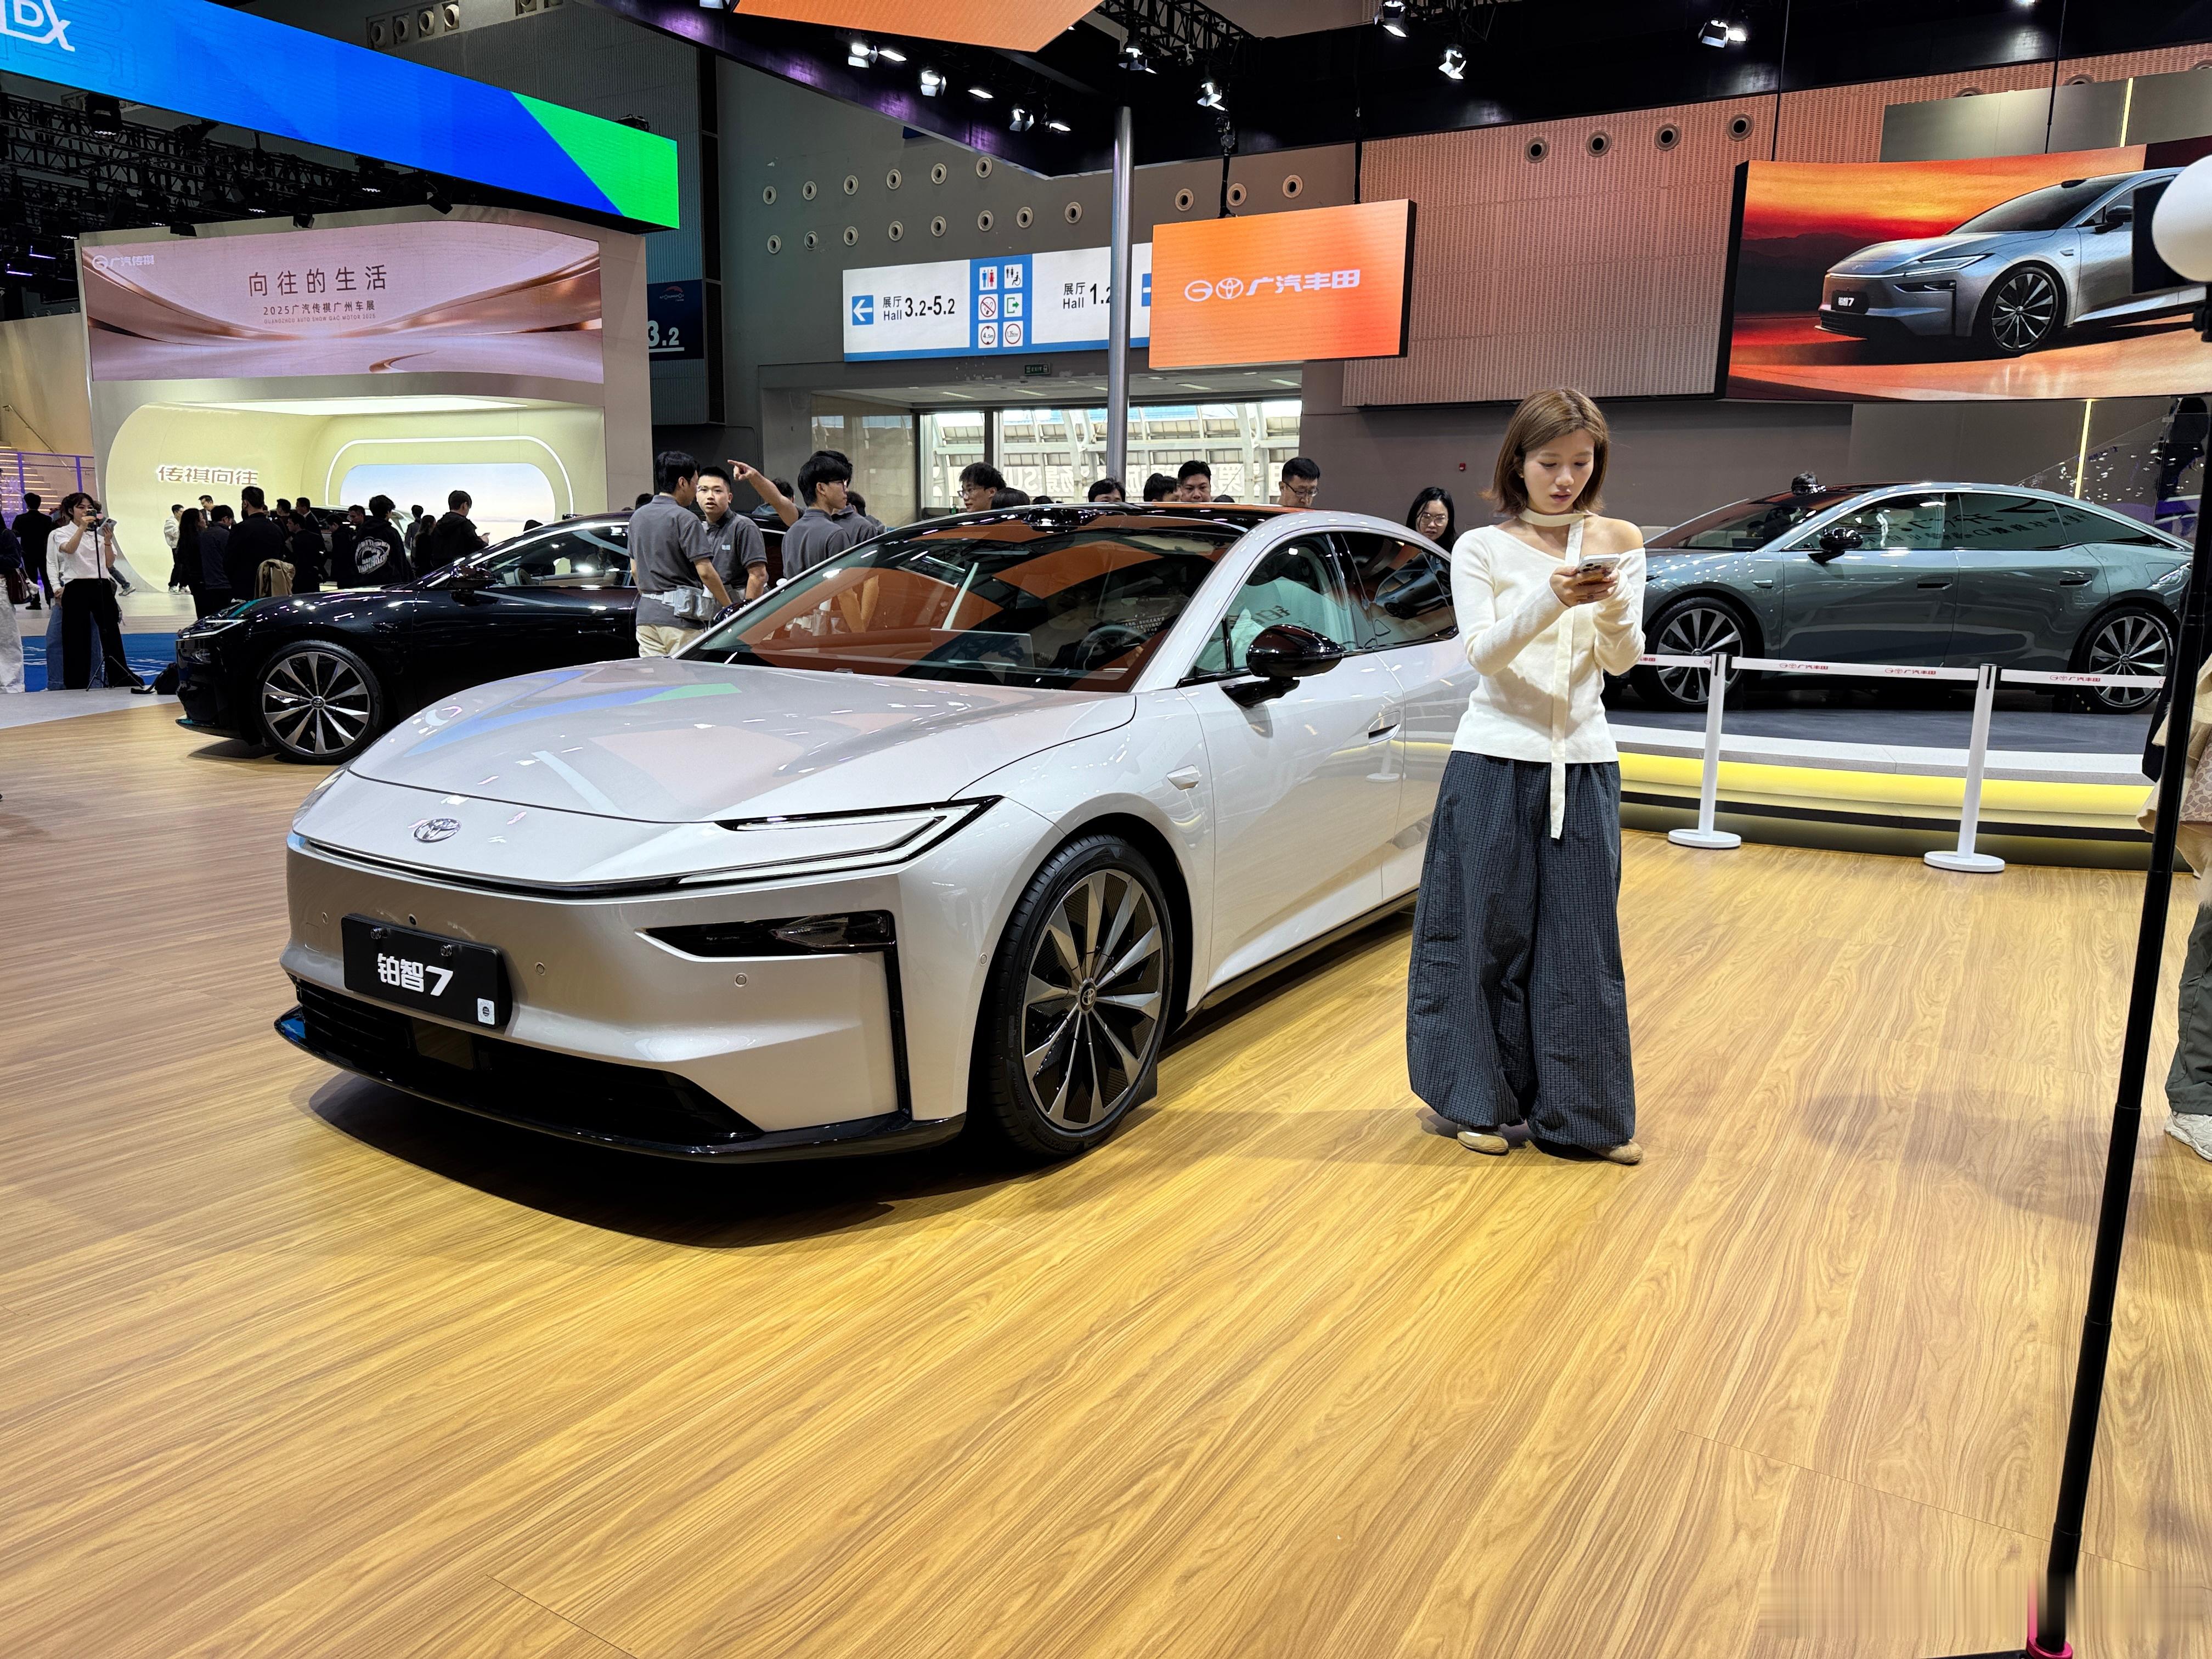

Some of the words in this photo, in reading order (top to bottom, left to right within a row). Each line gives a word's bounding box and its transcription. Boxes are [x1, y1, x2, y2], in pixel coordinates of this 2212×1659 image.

[249, 264, 387, 297] 向往的生活
[1063, 282, 1086, 296] 展厅
[1246, 269, 1361, 296] 广汽丰田
[883, 296, 902, 308] 展厅
[883, 309, 902, 321] Hall
[905, 295, 955, 317] 3.2-5.2
[1063, 297, 1084, 309] Hall
[648, 320, 679, 347] 3.2
[158, 466, 259, 486] 传祺向往
[377, 953, 454, 996] 铂智7
